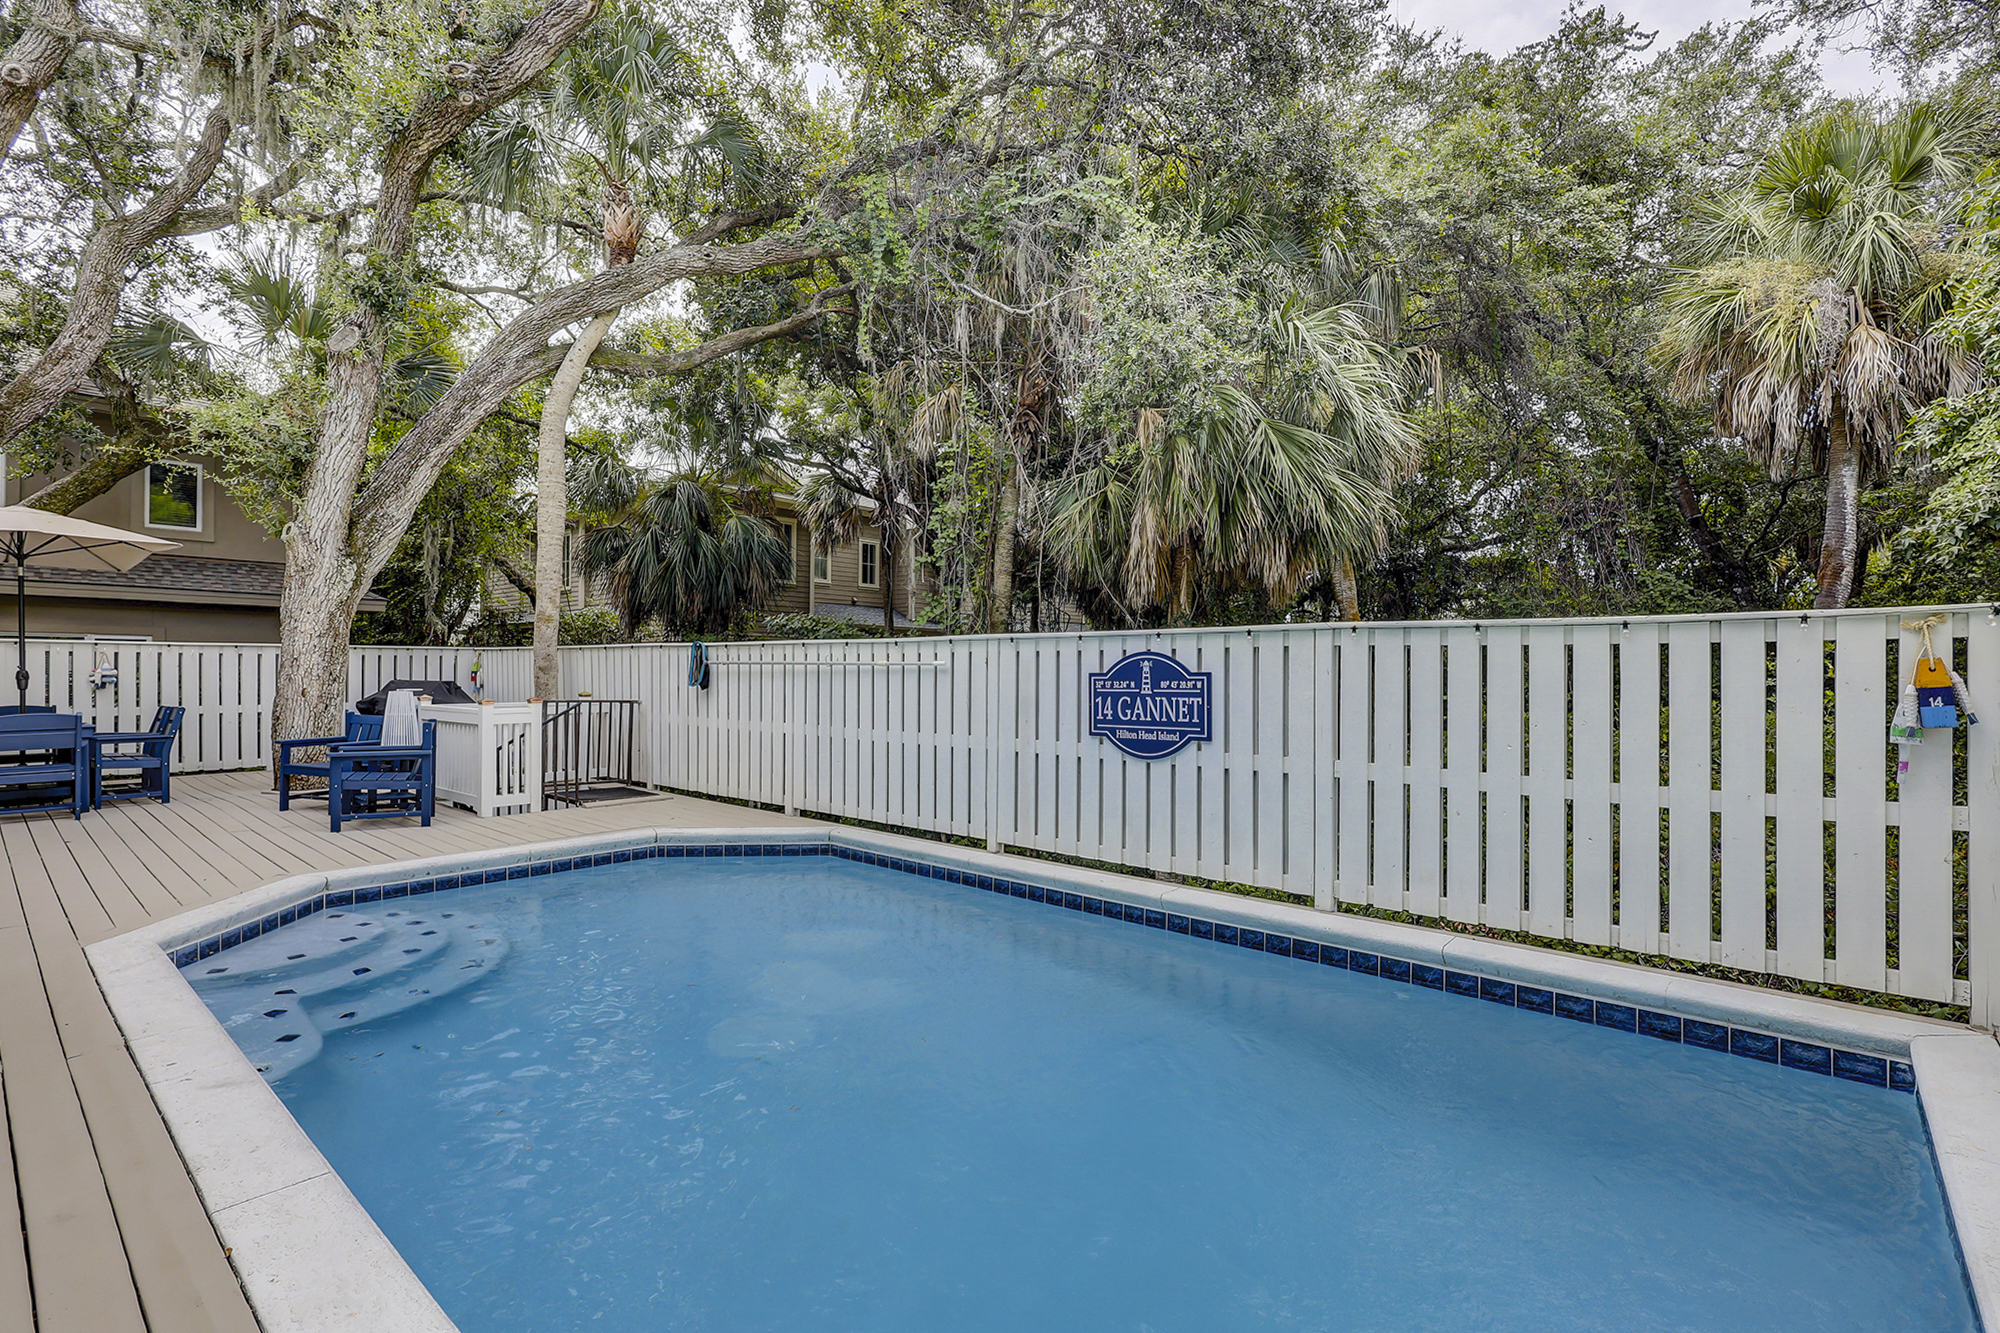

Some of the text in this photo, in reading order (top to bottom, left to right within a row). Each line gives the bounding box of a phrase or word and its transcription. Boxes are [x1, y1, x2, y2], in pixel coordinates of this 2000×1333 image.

[1130, 681, 1135, 689] N
[1196, 681, 1202, 689] W
[1928, 696, 1944, 708] 14
[1095, 696, 1202, 722] 14 GANNET
[1116, 730, 1180, 741] Hilton Head Island
